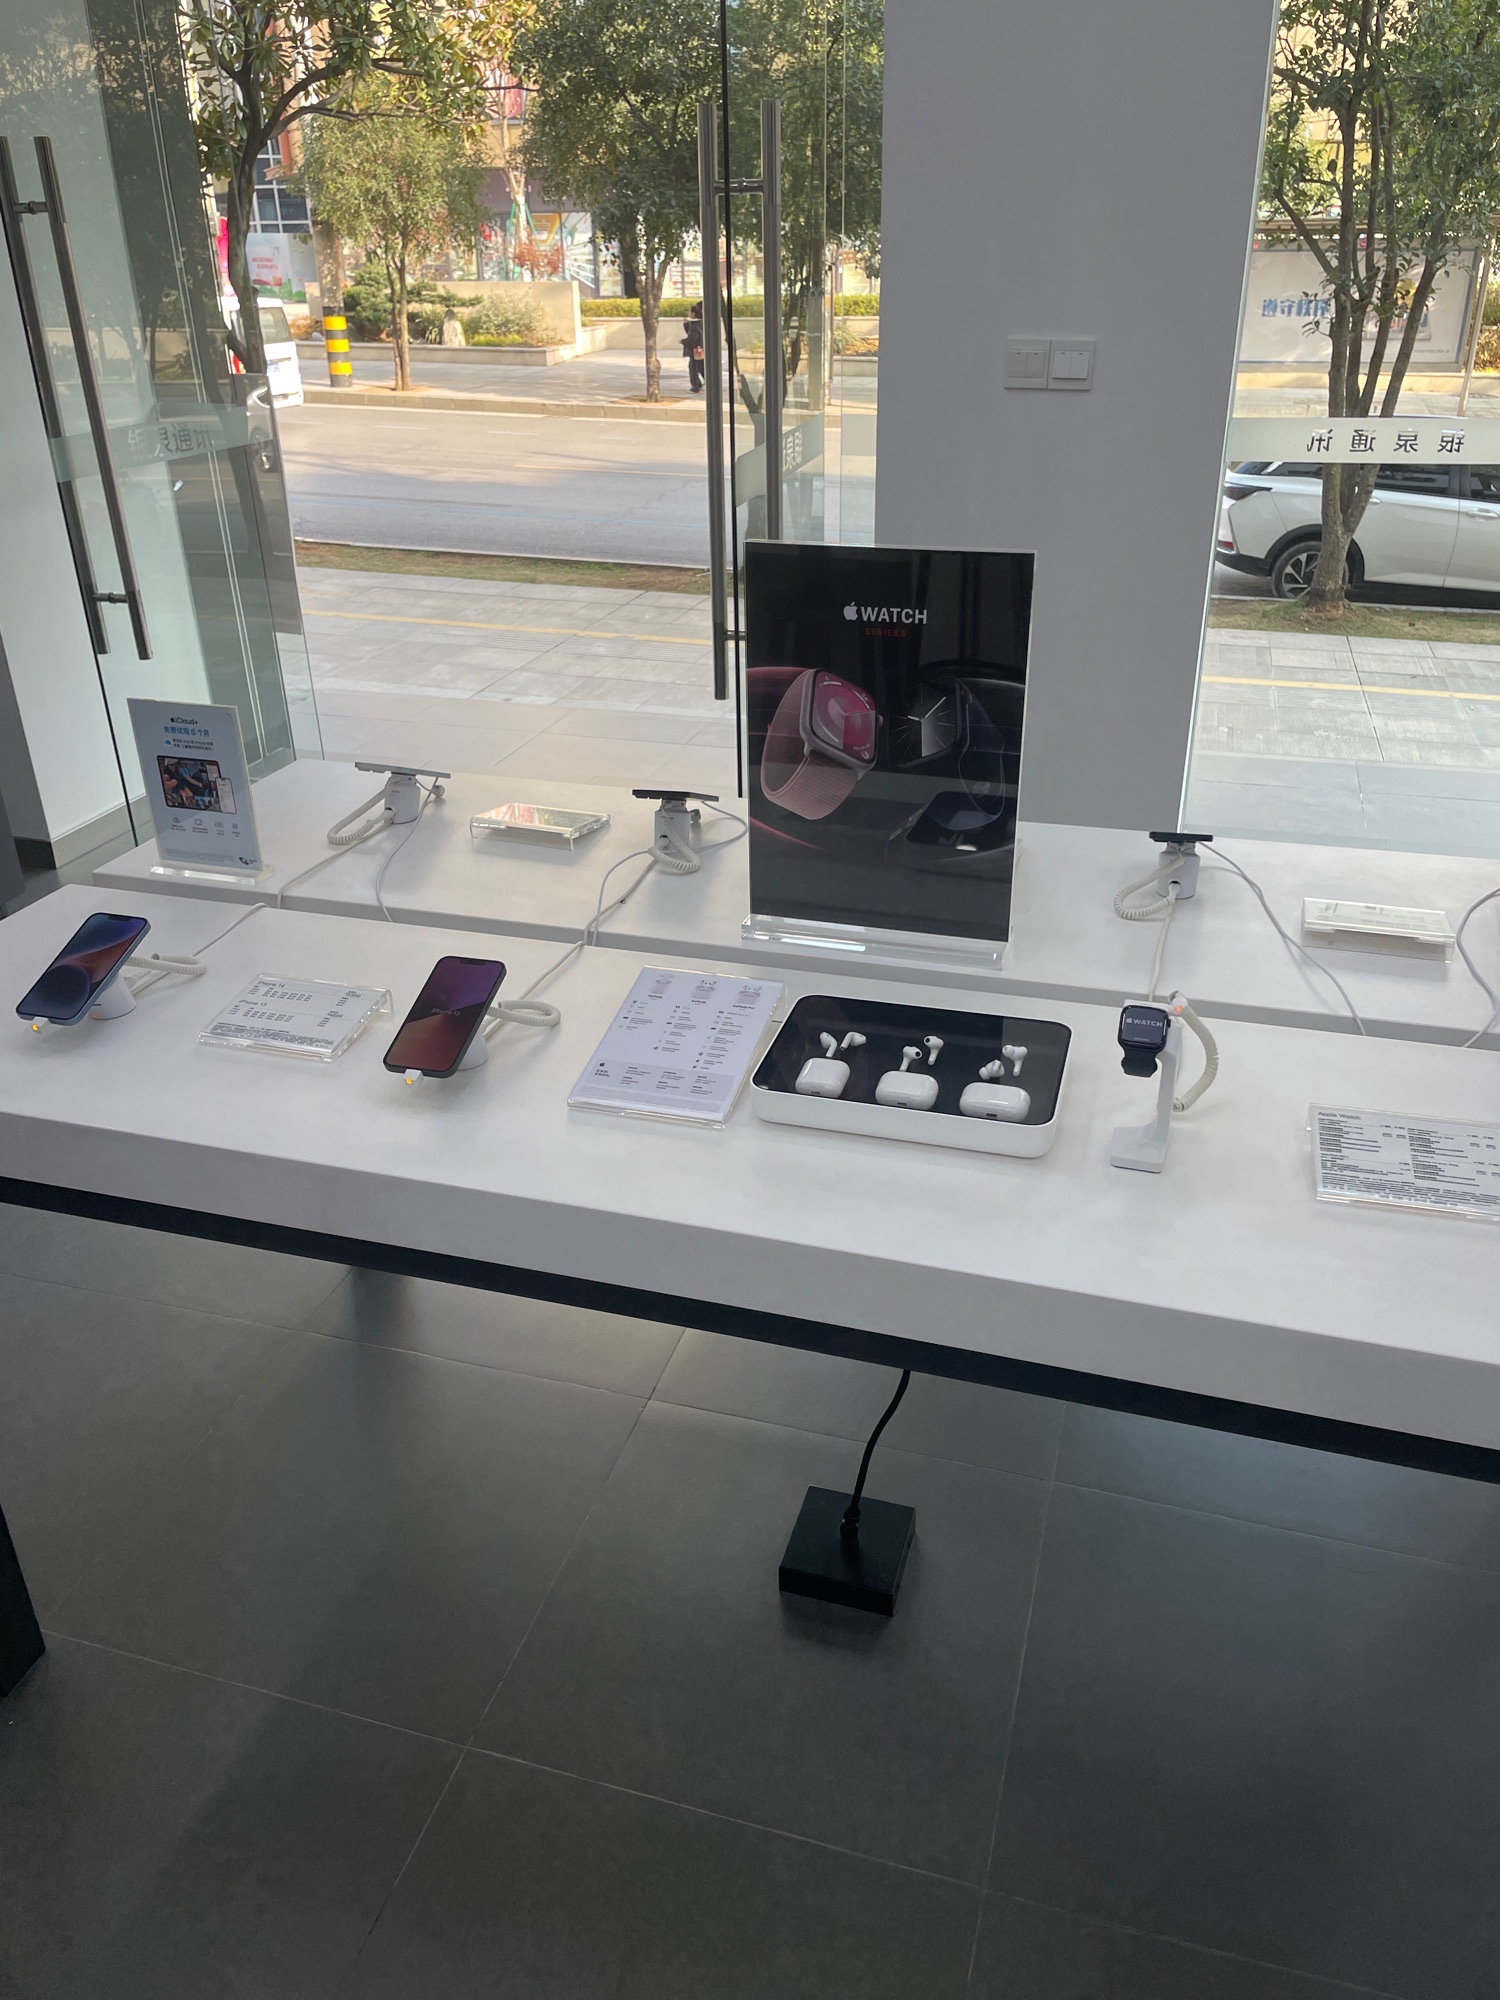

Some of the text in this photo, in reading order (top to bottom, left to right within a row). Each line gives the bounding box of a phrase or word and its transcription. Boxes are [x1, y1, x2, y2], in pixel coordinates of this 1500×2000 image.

[860, 606, 927, 625] WATCH
[865, 627, 899, 637] SERIES
[1133, 1018, 1164, 1028] WATCH
